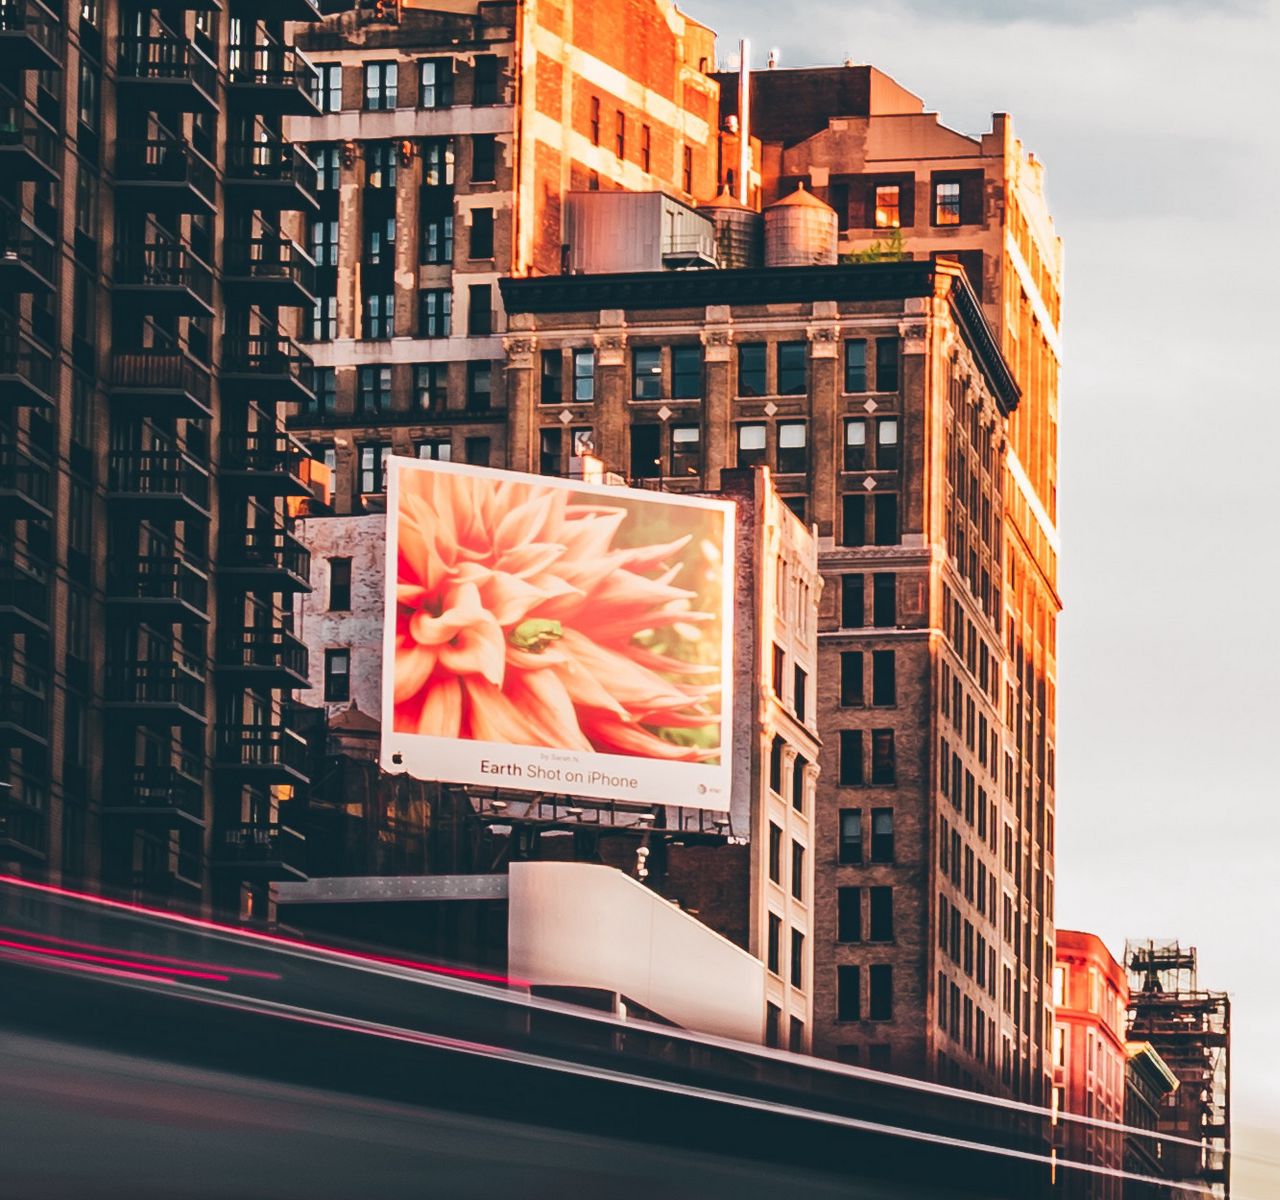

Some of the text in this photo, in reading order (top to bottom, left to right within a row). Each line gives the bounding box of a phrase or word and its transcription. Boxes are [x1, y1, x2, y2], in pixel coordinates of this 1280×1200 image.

[480, 760, 639, 789] Earth Shot on iPhone
